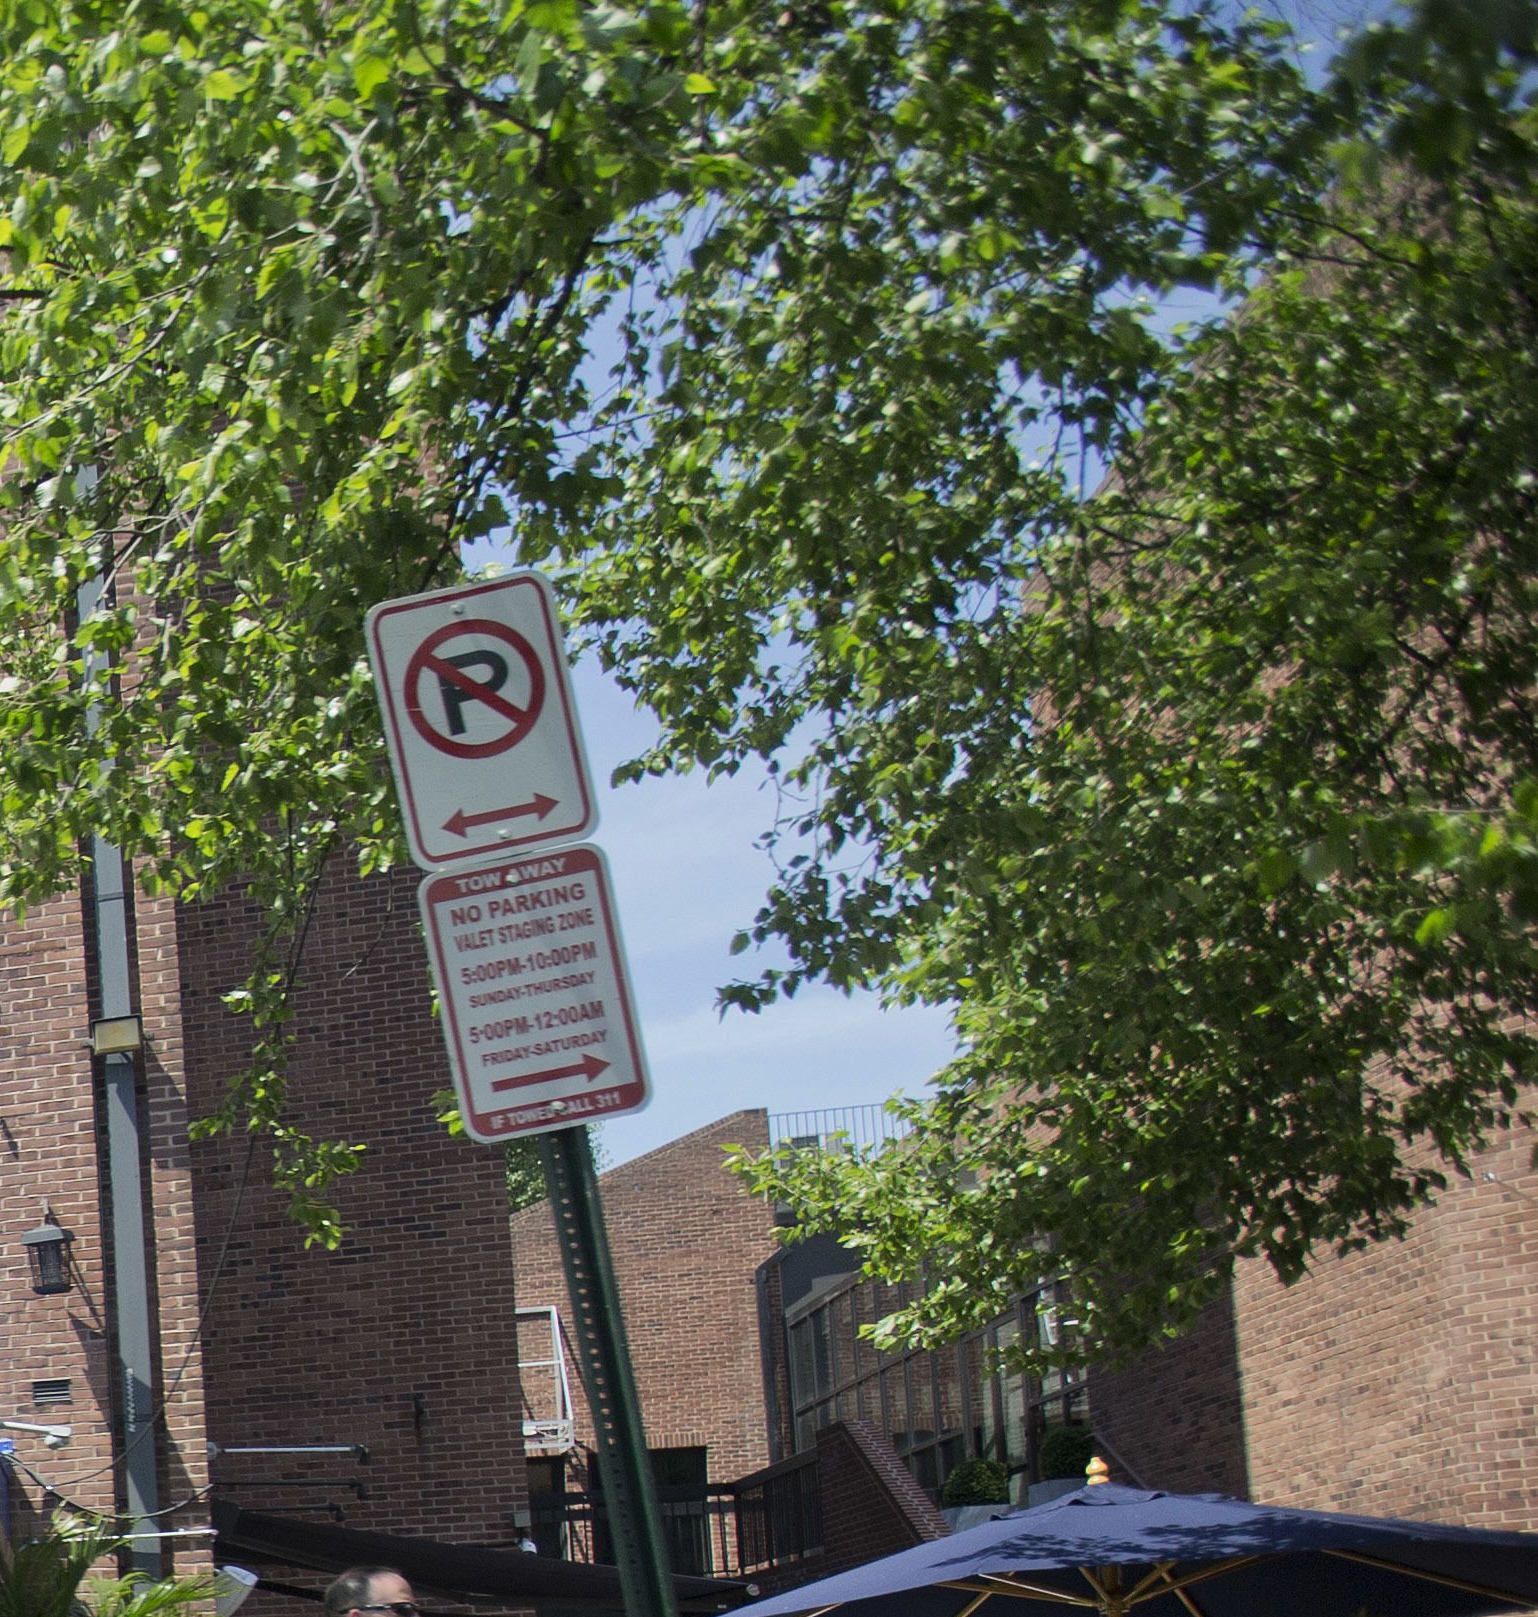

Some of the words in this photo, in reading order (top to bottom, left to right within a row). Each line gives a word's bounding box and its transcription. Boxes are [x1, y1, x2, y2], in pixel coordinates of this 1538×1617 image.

[455, 872, 501, 894] TOW
[510, 857, 567, 882] AWAY
[450, 904, 482, 926] NO
[488, 882, 586, 919] PARKING
[453, 929, 494, 952] VALET
[499, 915, 556, 944] STAGING
[557, 908, 595, 931] ZONE
[468, 970, 596, 1008] SUNDAY-THURSDAY
[481, 1029, 608, 1067] FRIDAY-SATURDAY
[490, 1115, 507, 1130] IF
[595, 1091, 621, 1109] 311
